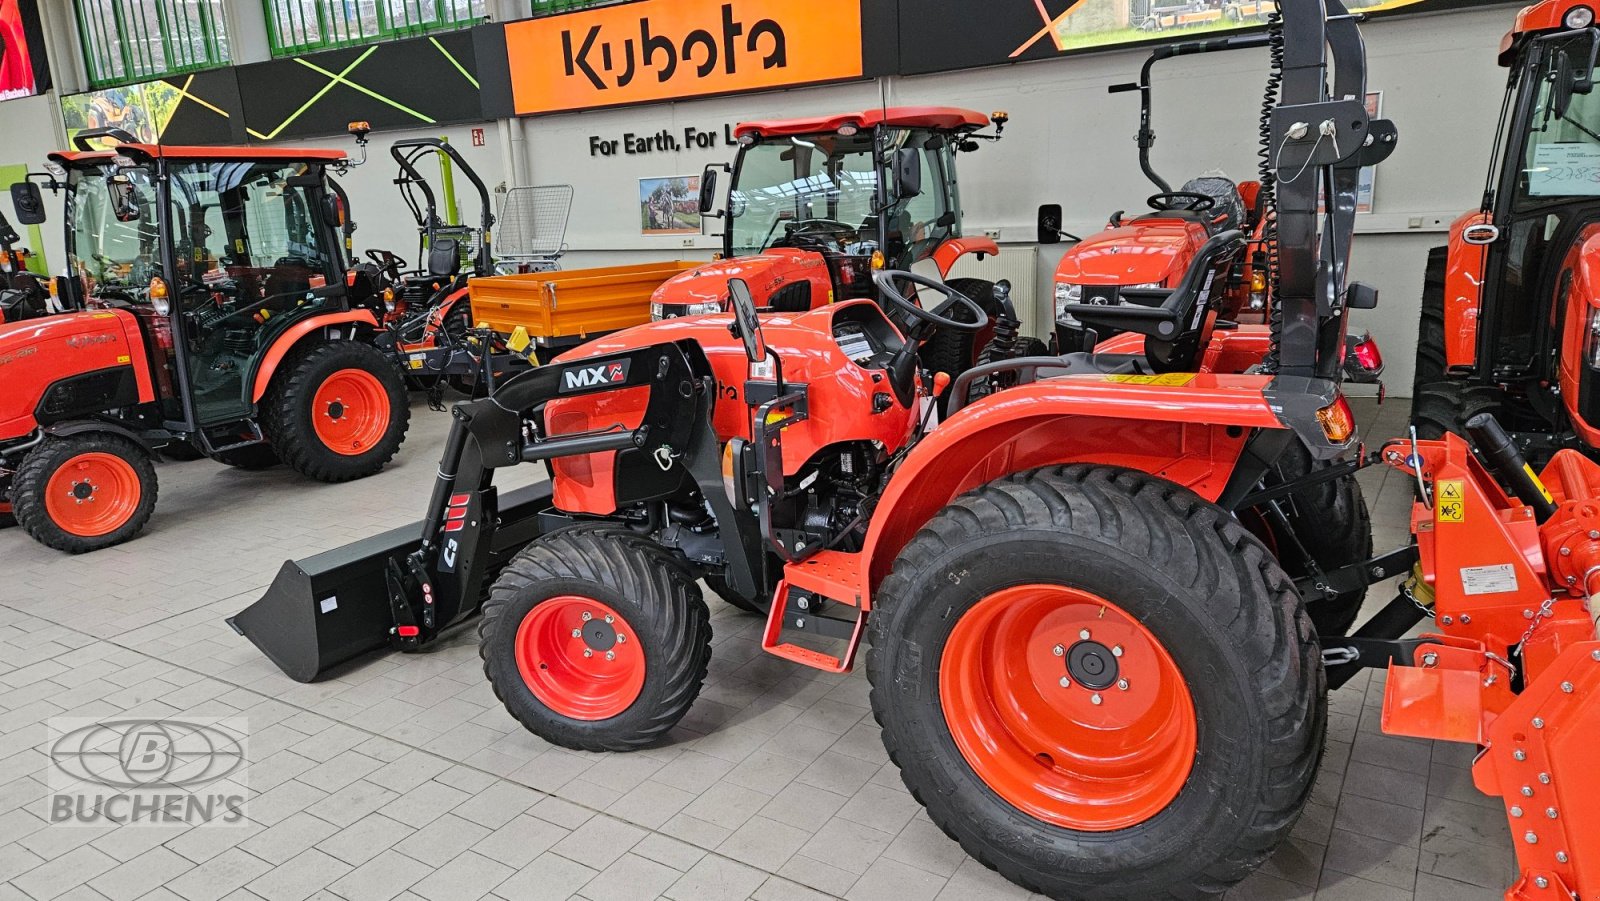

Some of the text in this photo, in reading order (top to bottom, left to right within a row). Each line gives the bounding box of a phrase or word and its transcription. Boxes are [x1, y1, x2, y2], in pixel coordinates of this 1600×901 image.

[561, 3, 787, 90] Kubota
[589, 136, 619, 157] For
[623, 129, 681, 155] Earth,
[684, 126, 717, 149] For
[565, 365, 609, 389] MX
[443, 538, 458, 568] C3
